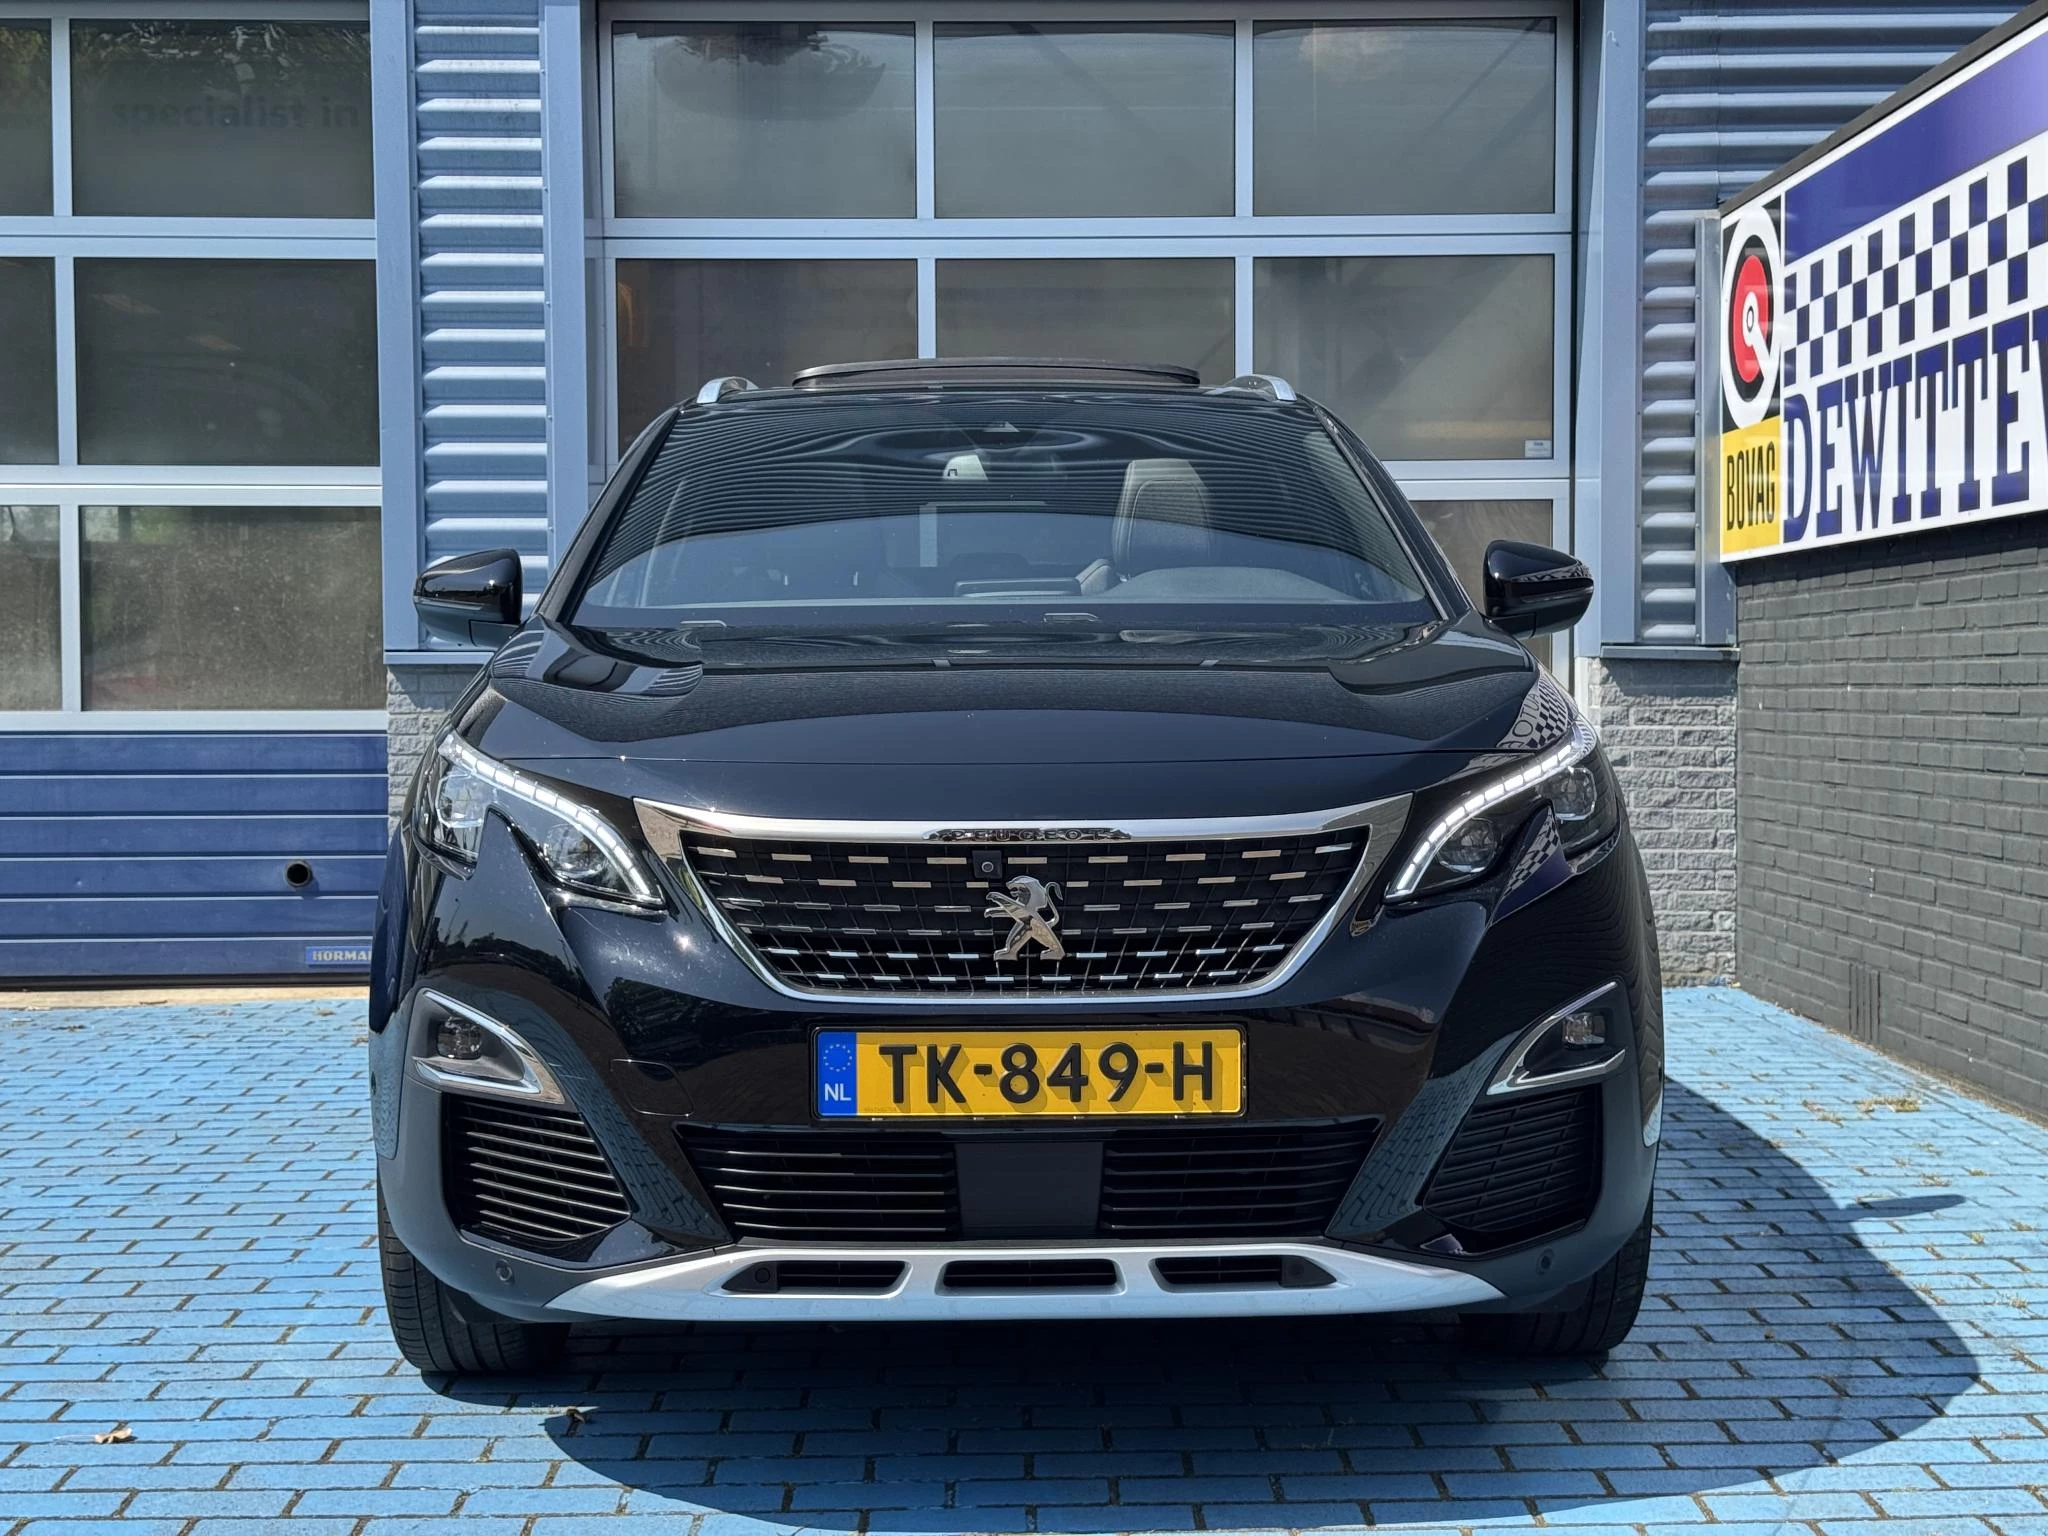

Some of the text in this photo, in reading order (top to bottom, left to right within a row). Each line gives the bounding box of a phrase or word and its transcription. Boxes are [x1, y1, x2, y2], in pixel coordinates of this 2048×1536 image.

[321, 96, 359, 129] in
[1726, 441, 1775, 531] BOVAG
[950, 828, 1107, 841] PEUGEOT
[879, 1041, 1213, 1105] TK-849-H
[824, 1083, 851, 1102] NL
